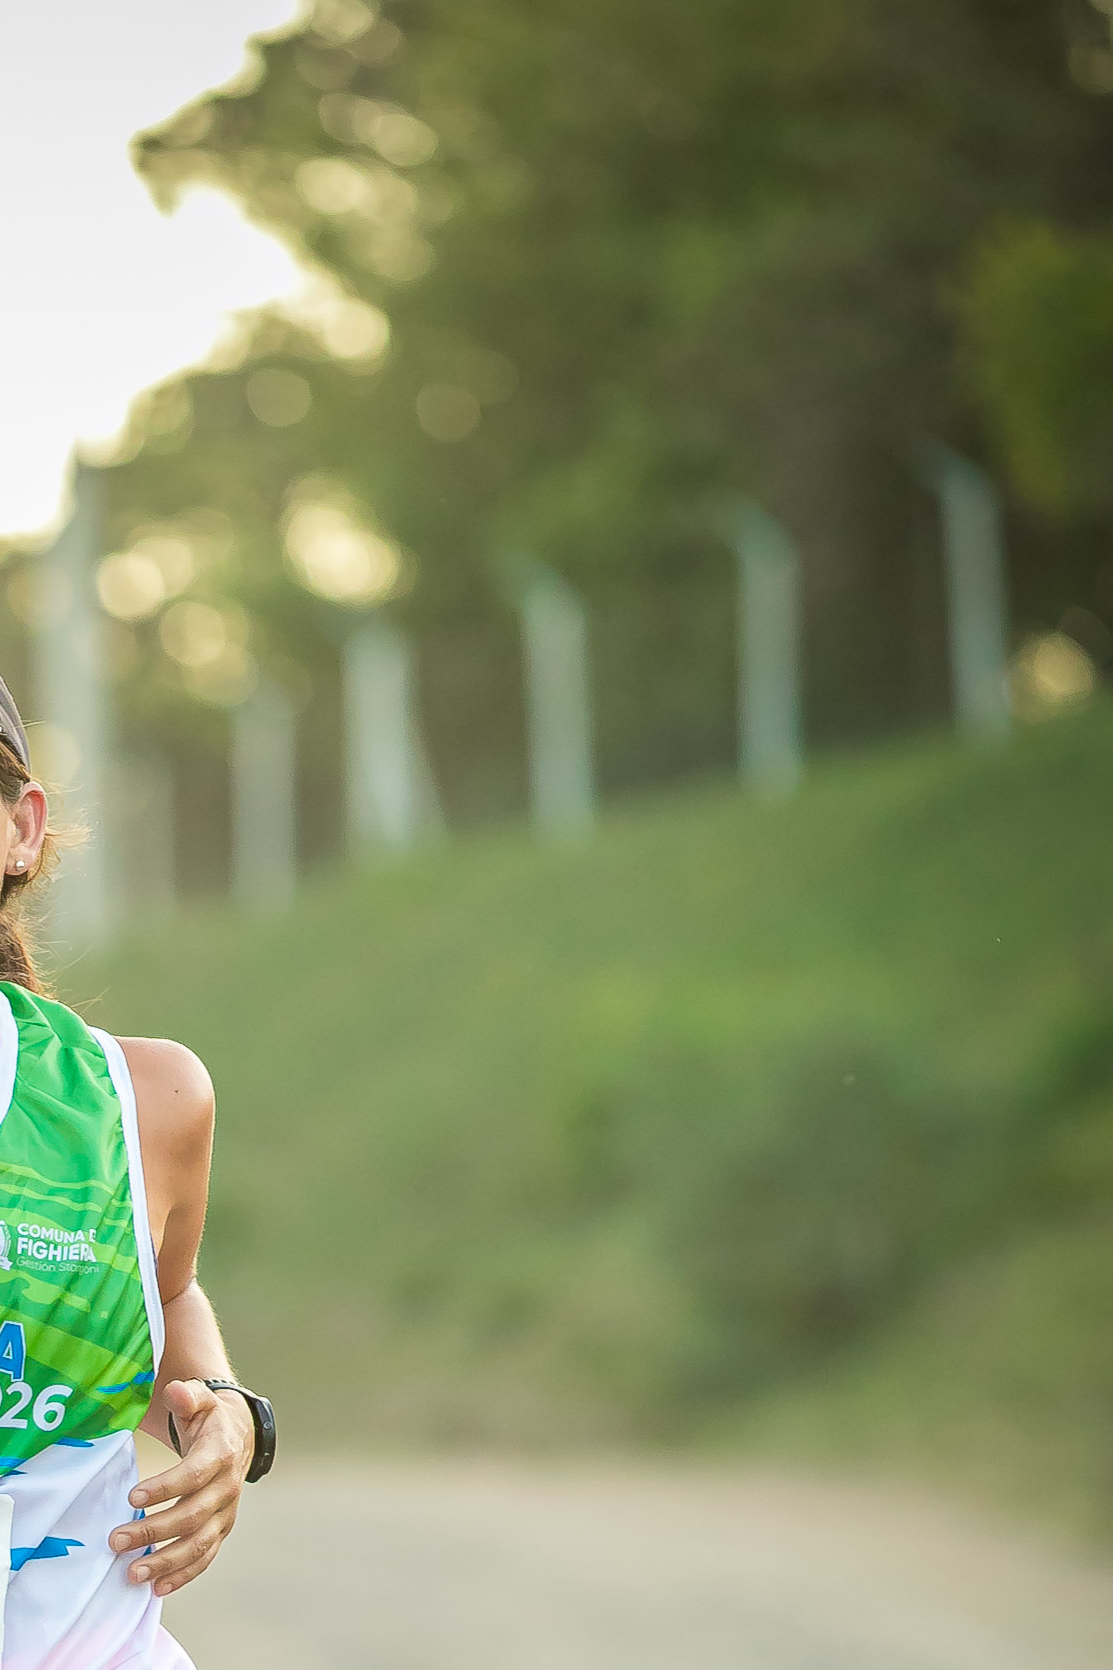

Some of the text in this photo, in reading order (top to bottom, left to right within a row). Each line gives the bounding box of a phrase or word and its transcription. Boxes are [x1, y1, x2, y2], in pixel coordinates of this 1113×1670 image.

[17, 1223, 85, 1243] COMUNA
[17, 1237, 97, 1262] FIGHIERA
[16, 1256, 56, 1272] Gestión
